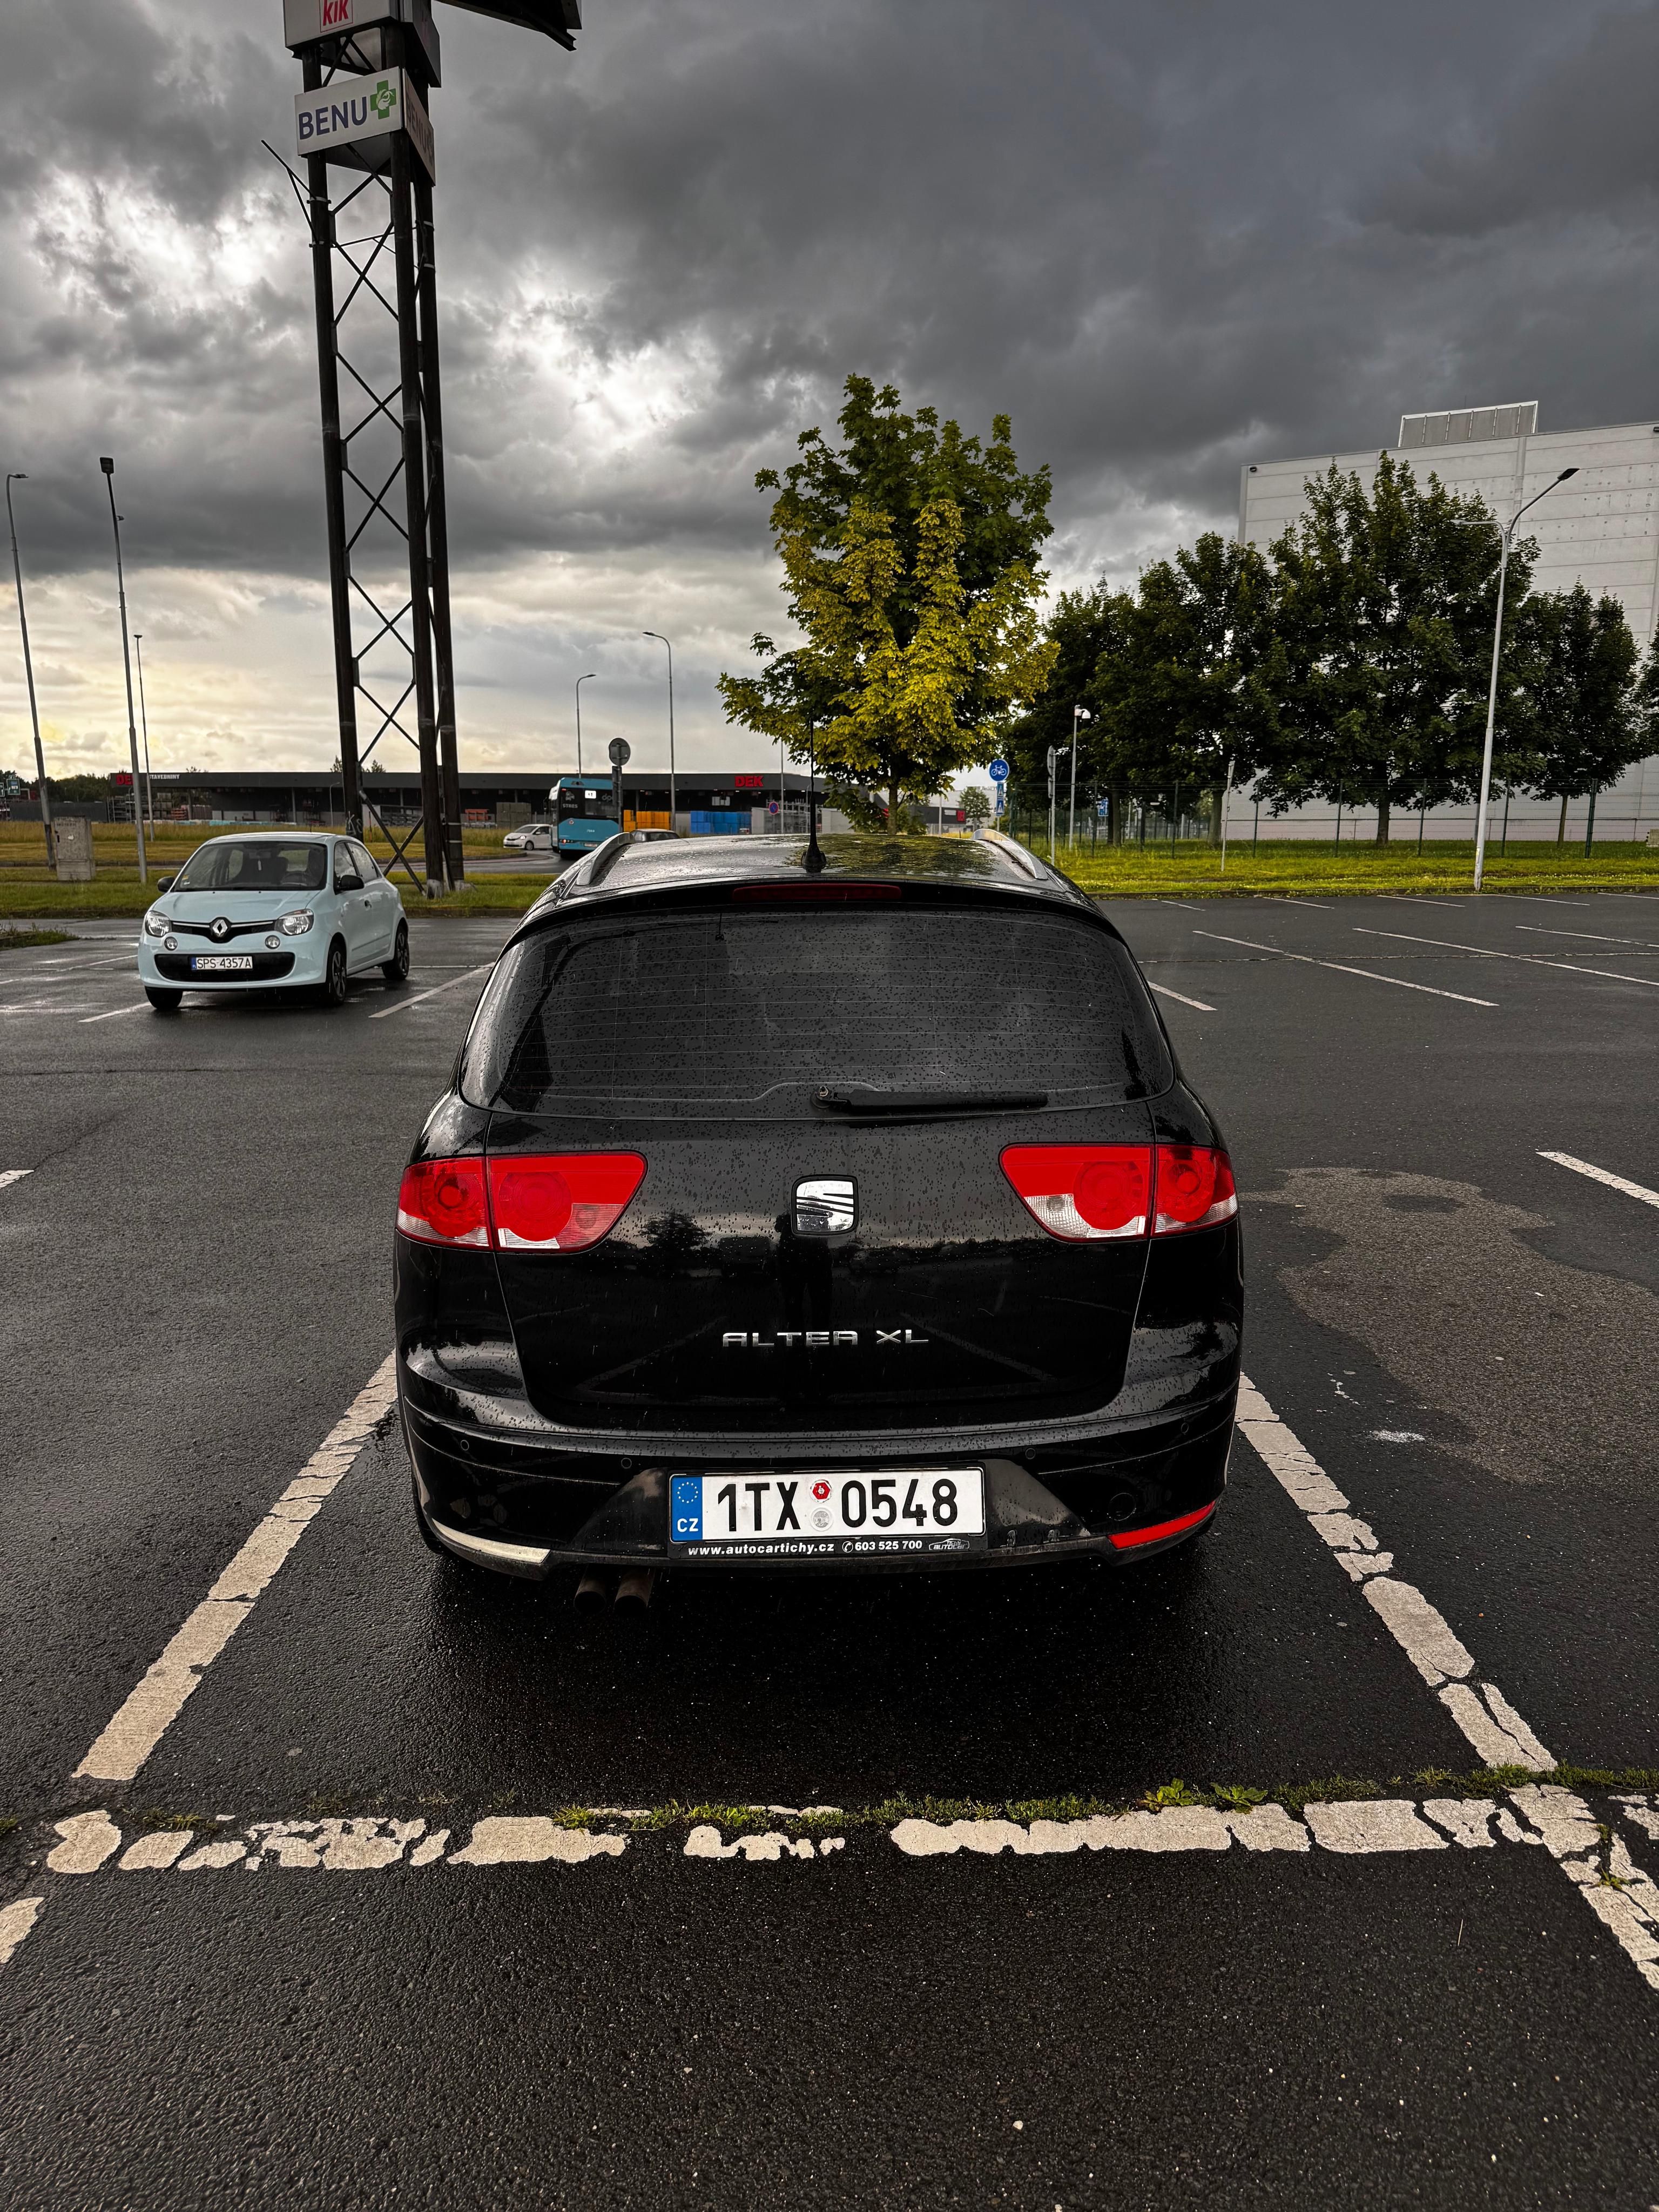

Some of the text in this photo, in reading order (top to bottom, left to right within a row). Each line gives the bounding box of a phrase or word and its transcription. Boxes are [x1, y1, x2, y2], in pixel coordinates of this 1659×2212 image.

[299, 96, 367, 140] BENU
[406, 92, 427, 153] BENU
[116, 774, 133, 785] DE
[734, 775, 764, 787] DEK
[197, 957, 251, 968] SPS 4357A
[723, 1330, 929, 1347] ALTEA XL
[718, 1478, 958, 1532] 1TX 0548
[677, 1518, 699, 1532] CZ
[688, 1540, 922, 1555] www.autocartichy.cz 603 525 700
